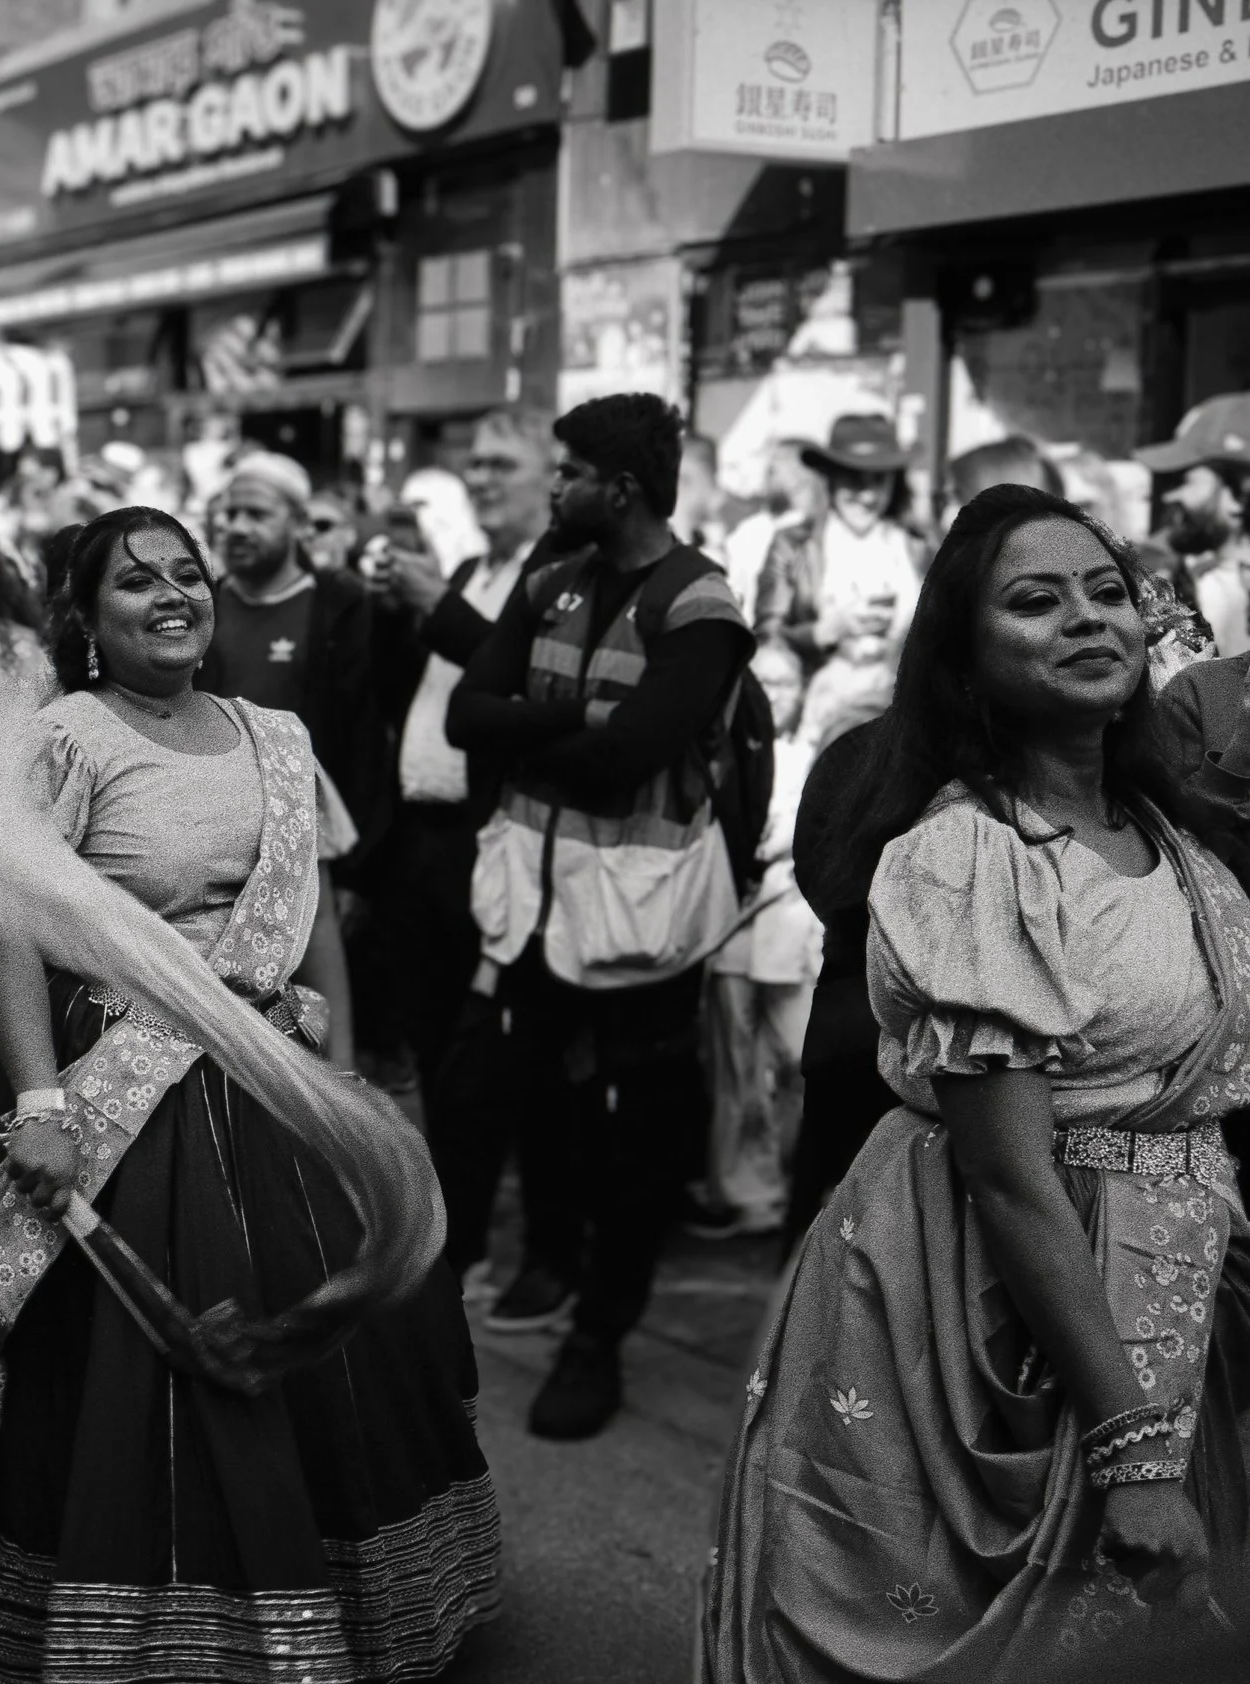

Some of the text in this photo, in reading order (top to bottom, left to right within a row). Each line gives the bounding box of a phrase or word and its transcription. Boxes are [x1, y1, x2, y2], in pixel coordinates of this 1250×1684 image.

[1086, 50, 1210, 89] Japanese
[1219, 39, 1237, 64] &
[41, 100, 183, 197] AMAR
[187, 45, 349, 152] GAON
